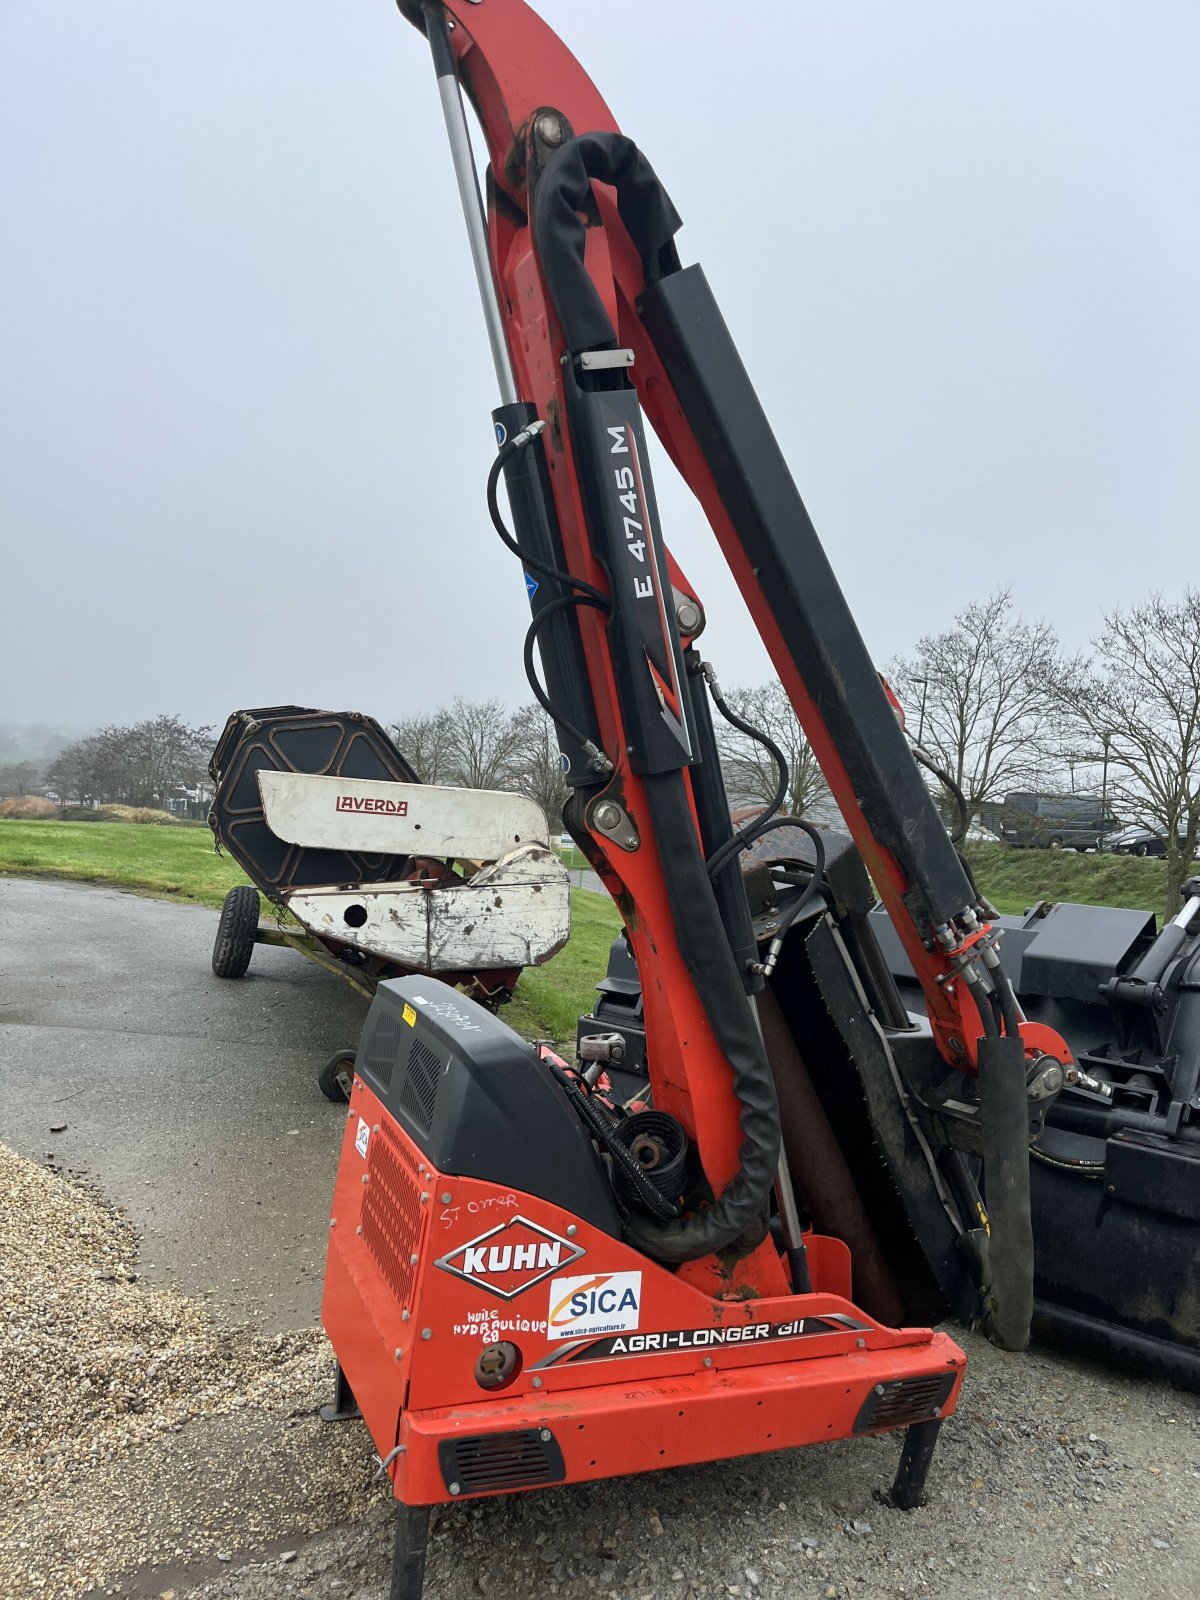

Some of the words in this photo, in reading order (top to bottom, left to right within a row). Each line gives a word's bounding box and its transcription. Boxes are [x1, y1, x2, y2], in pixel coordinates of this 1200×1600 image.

[607, 426, 629, 454] M
[614, 467, 645, 562] 4745
[634, 575, 654, 599] E
[336, 796, 408, 816] LAVERDA
[440, 1206, 461, 1229] ST
[462, 1241, 561, 1274] KUHN
[570, 1288, 638, 1316] SICA
[560, 1323, 626, 1337] www.sica-agriculture.fr
[610, 1323, 769, 1354] AGRI-LONGER
